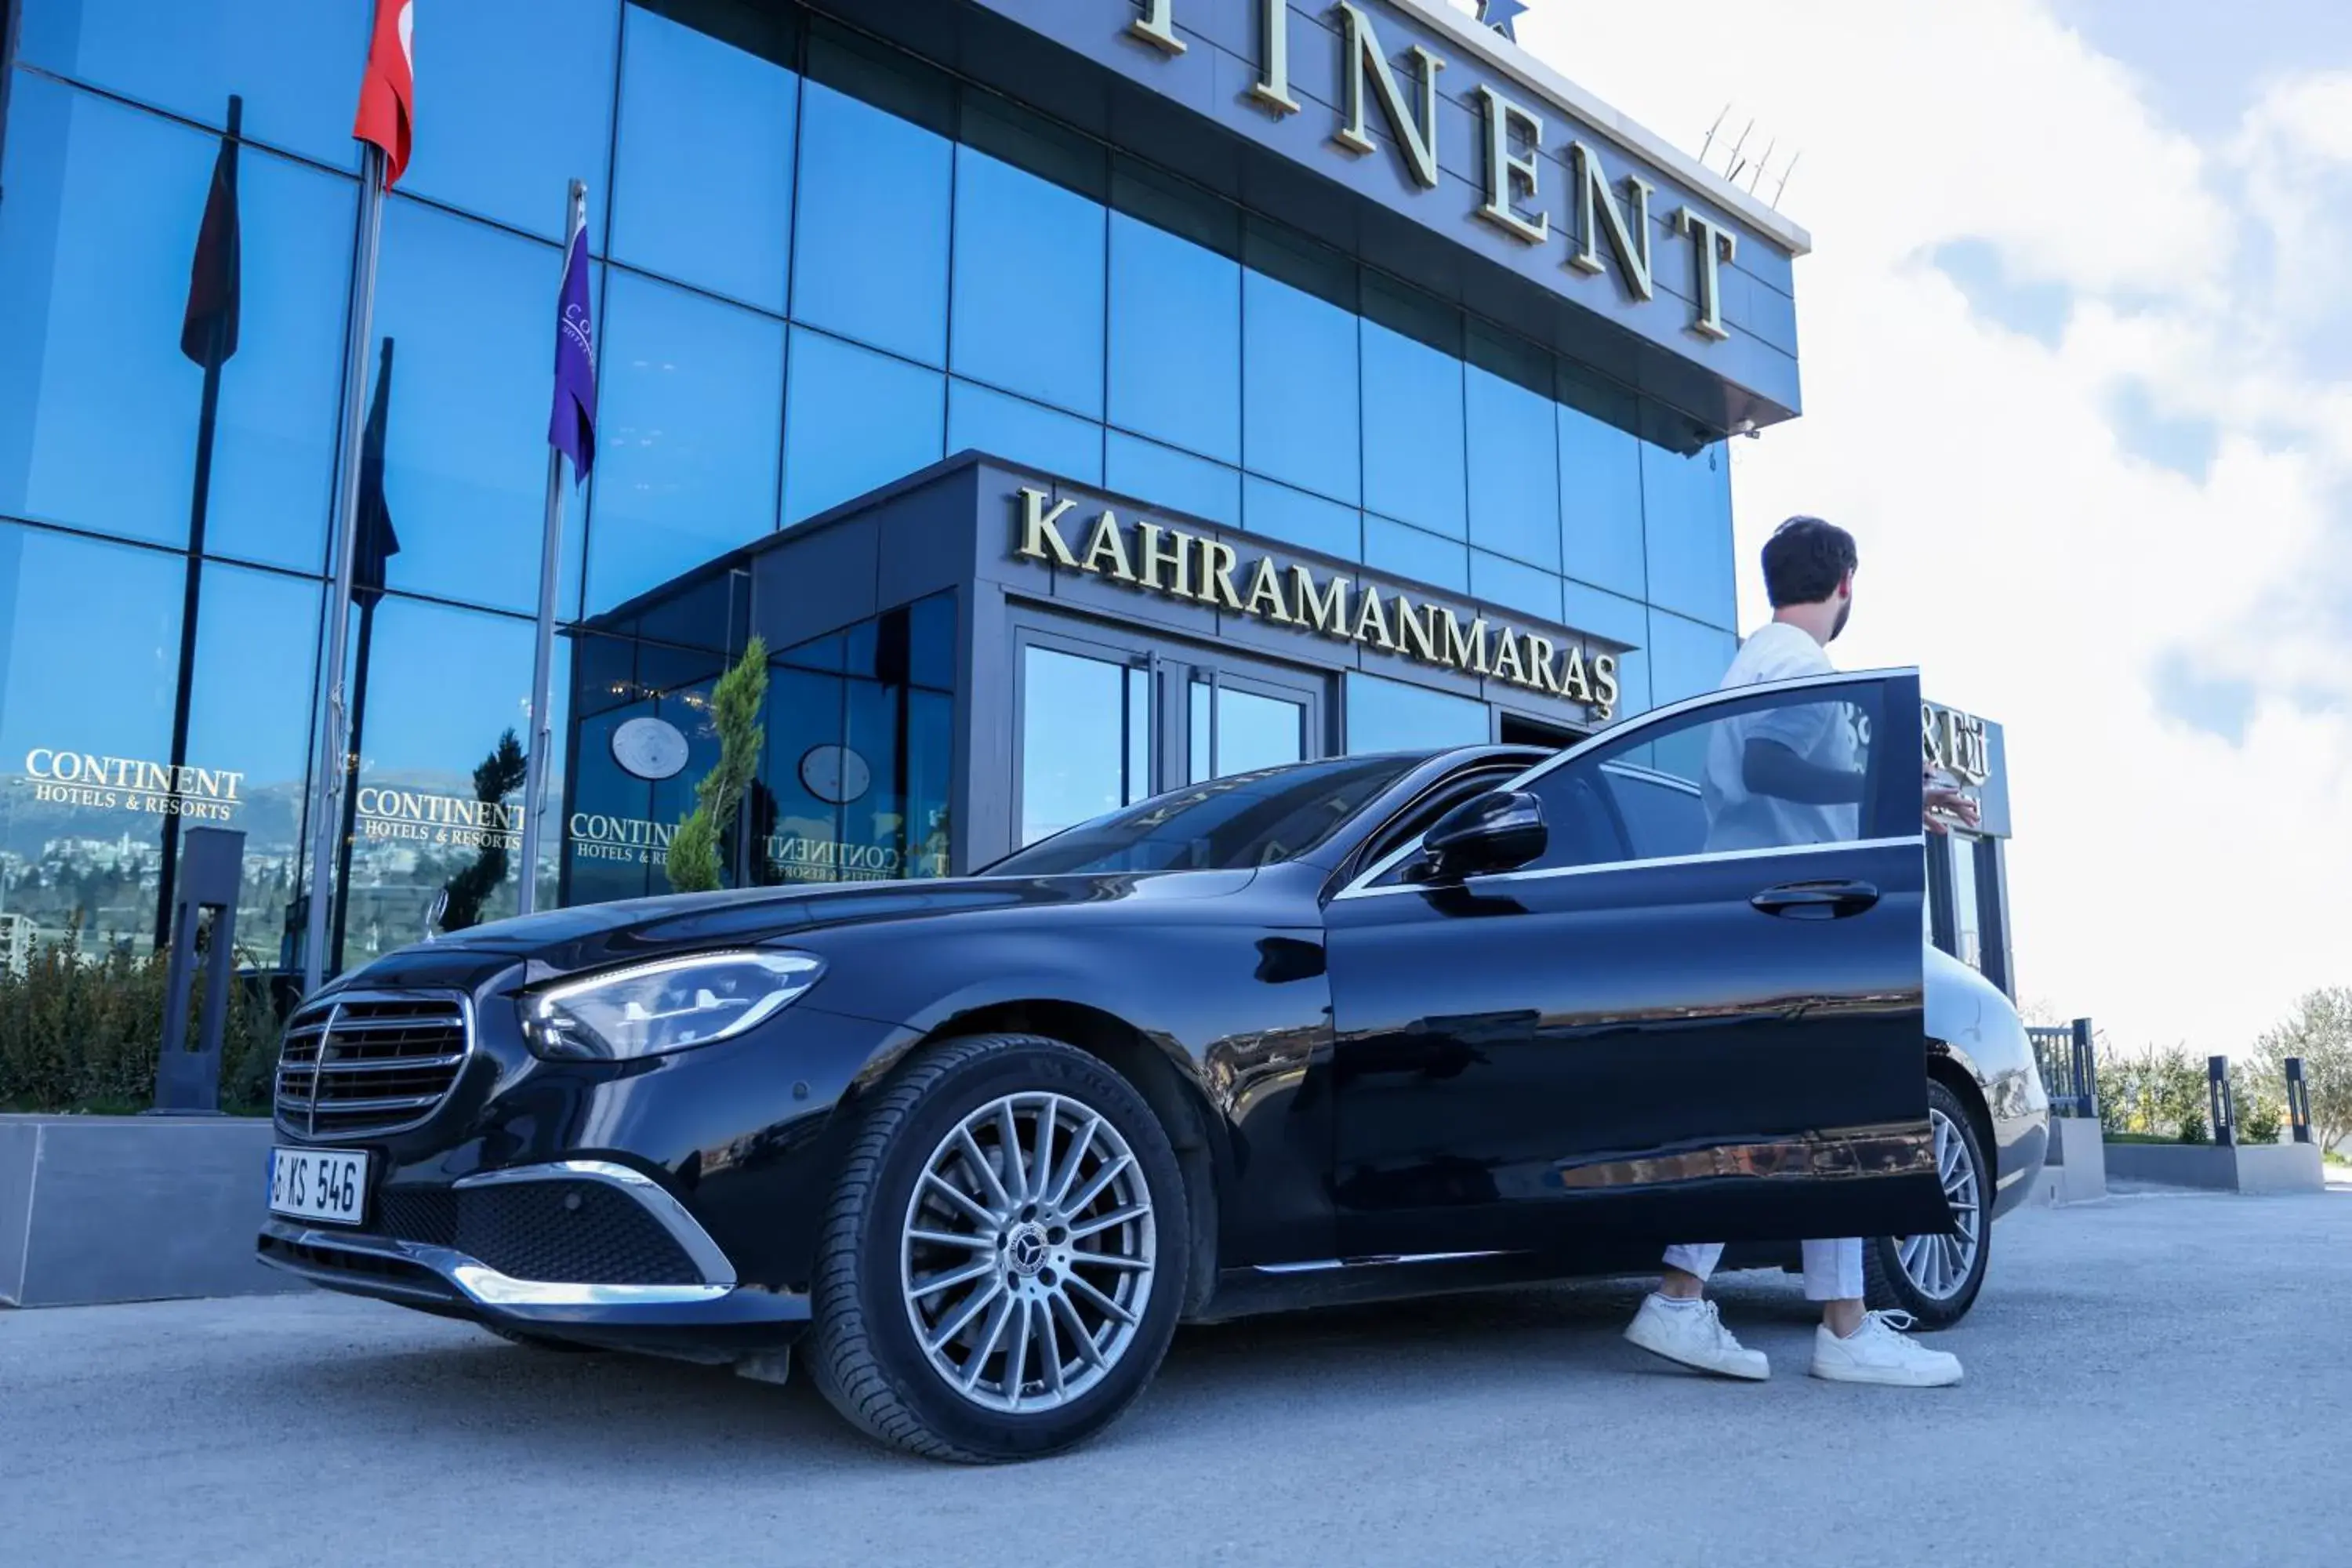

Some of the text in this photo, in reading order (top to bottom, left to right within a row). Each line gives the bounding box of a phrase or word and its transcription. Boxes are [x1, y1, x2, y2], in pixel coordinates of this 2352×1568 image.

[1018, 487, 1618, 721] KAHRAMANMARAŞ
[26, 748, 244, 799] CONTINENT
[36, 785, 230, 821] HOTELS & RESORTS
[357, 787, 524, 829] CONTINENT
[365, 819, 521, 851] HOTELS & RESORTS
[577, 842, 633, 862] HOTELS
[639, 851, 649, 863] &
[317, 1160, 356, 1212] 546
